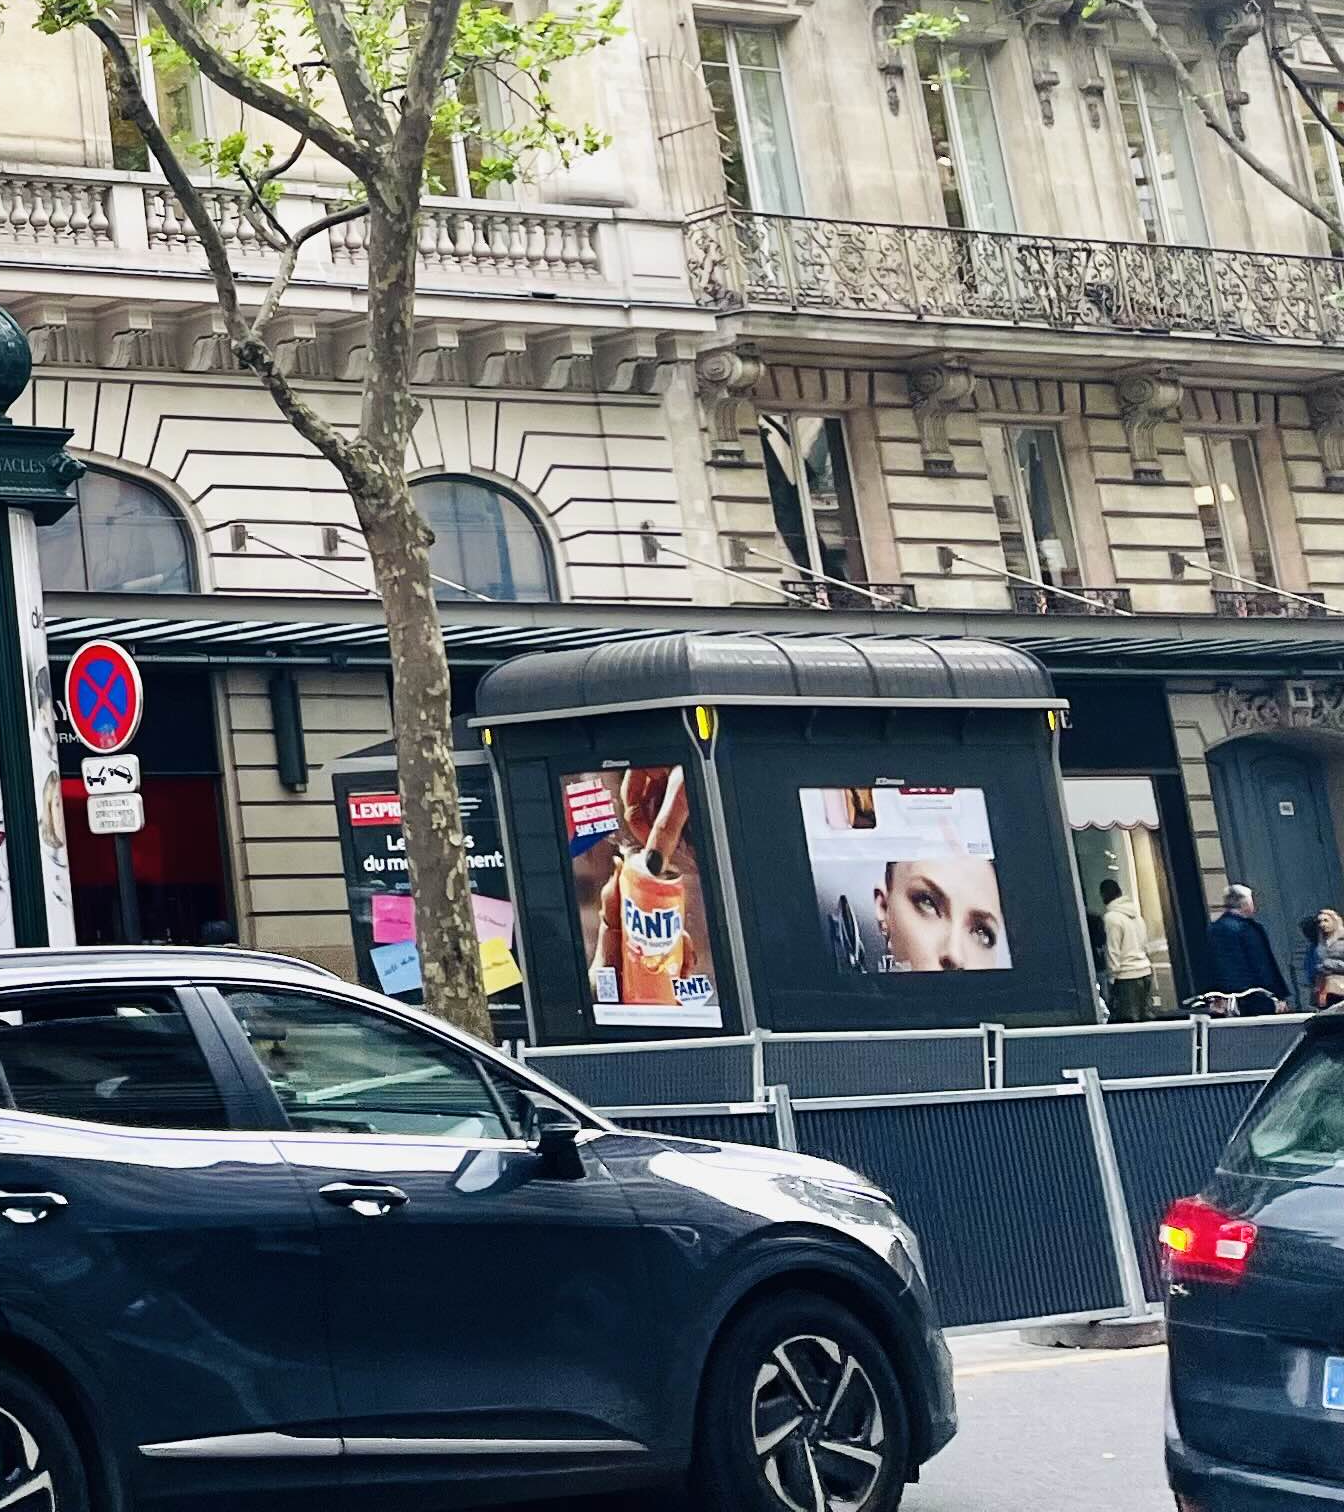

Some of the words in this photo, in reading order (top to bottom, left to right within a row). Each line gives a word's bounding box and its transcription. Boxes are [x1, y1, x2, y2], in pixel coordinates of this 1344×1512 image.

[363, 854, 385, 872] du
[623, 899, 681, 939] FANTA
[672, 977, 712, 999] FANTA
